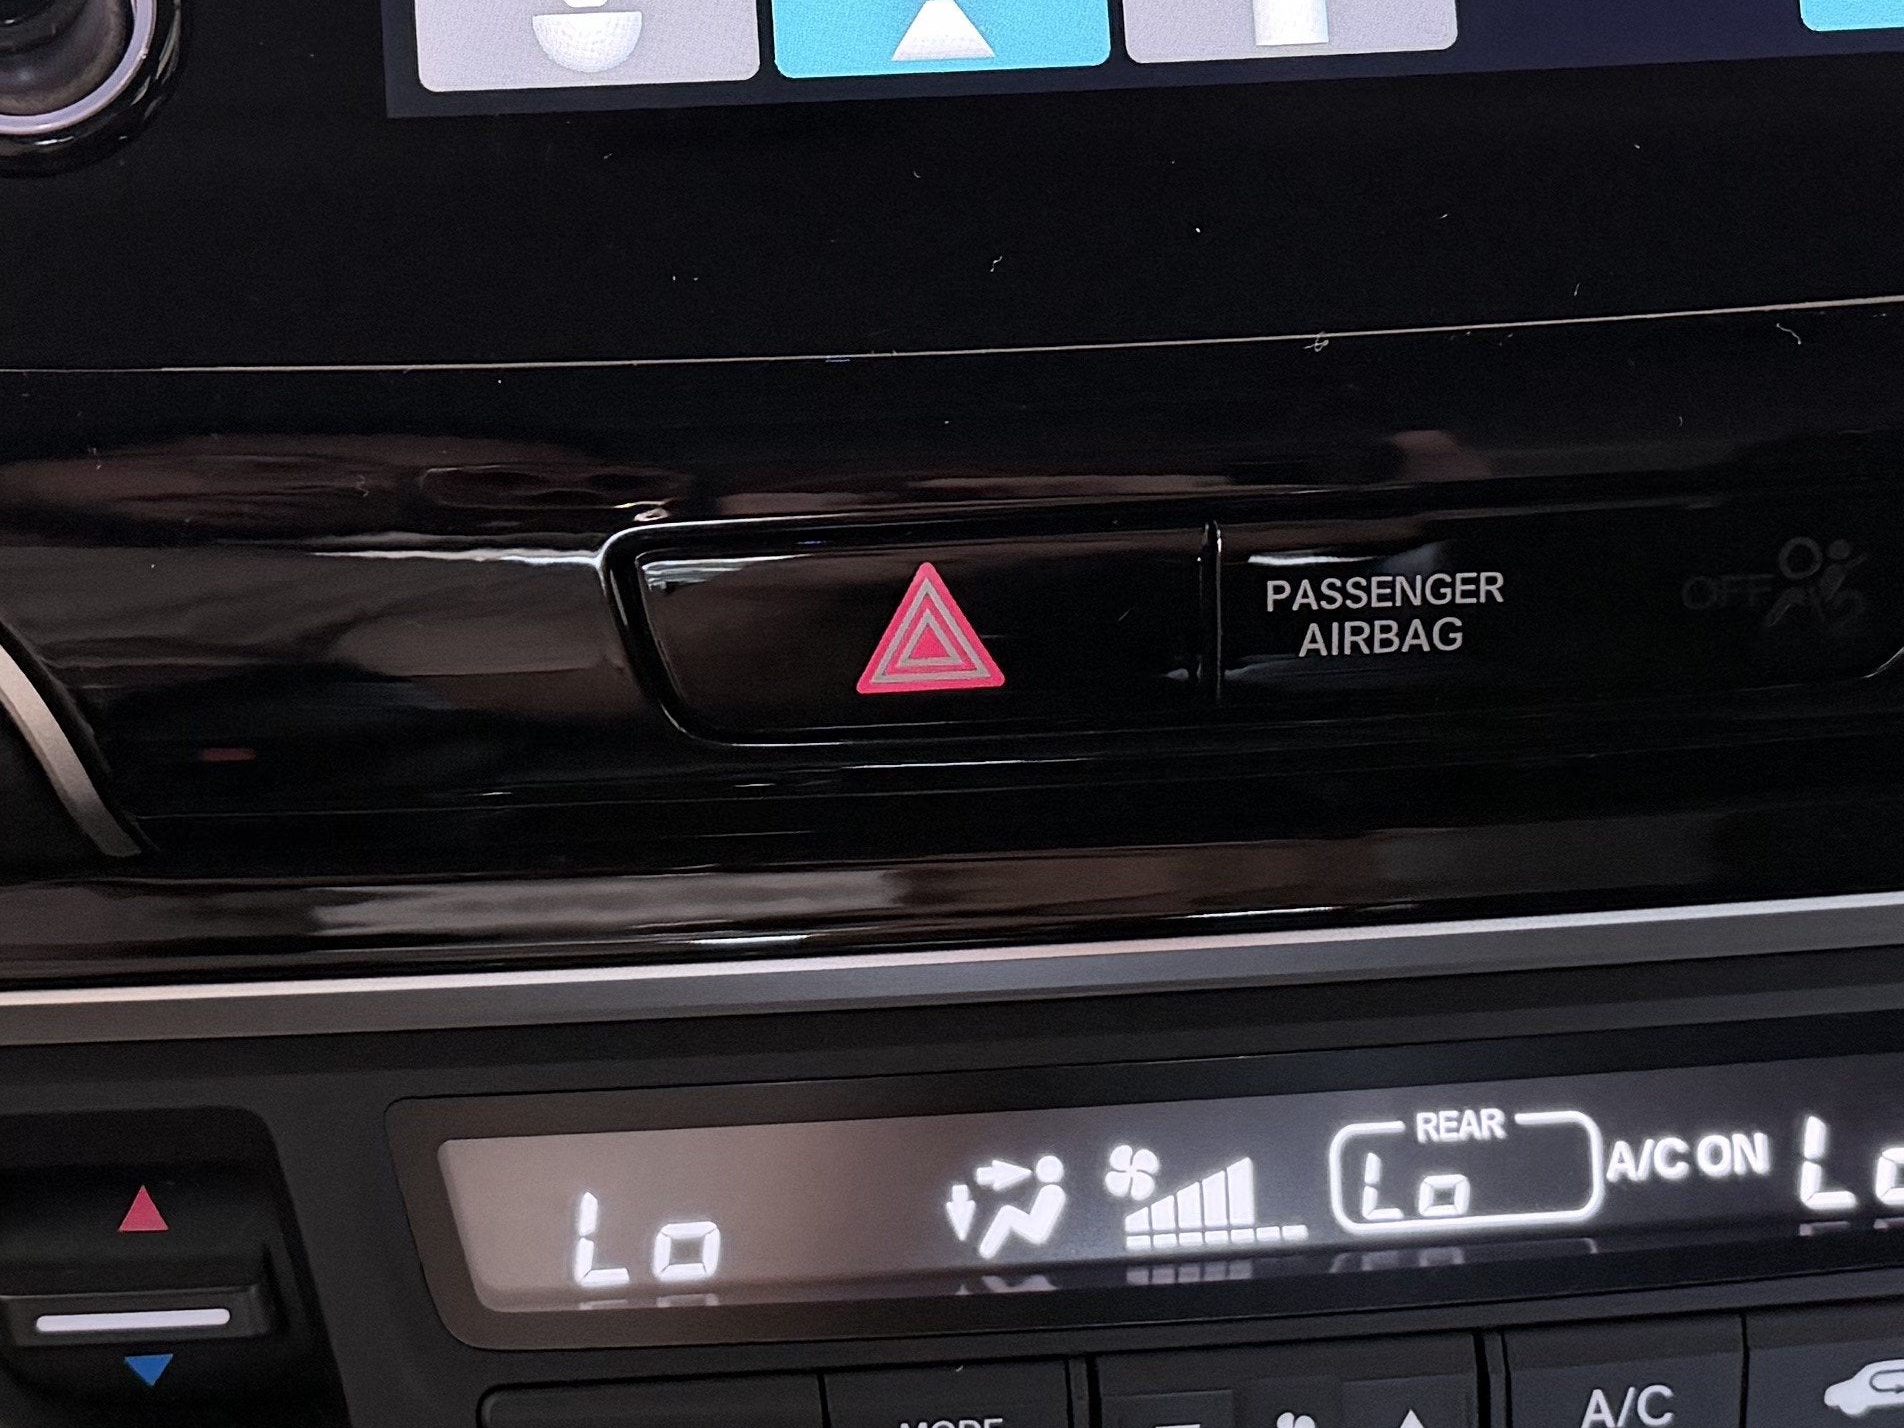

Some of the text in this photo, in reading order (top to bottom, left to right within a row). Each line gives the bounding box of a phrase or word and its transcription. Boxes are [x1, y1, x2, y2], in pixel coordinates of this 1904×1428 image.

[1266, 571, 1504, 613] PASSENGER
[1298, 616, 1464, 658] AIRBAG
[1414, 1107, 1508, 1144] REAR
[1605, 1131, 1772, 1183] A/C ON
[1361, 1151, 1472, 1221] Lo
[572, 1190, 722, 1289] Lo
